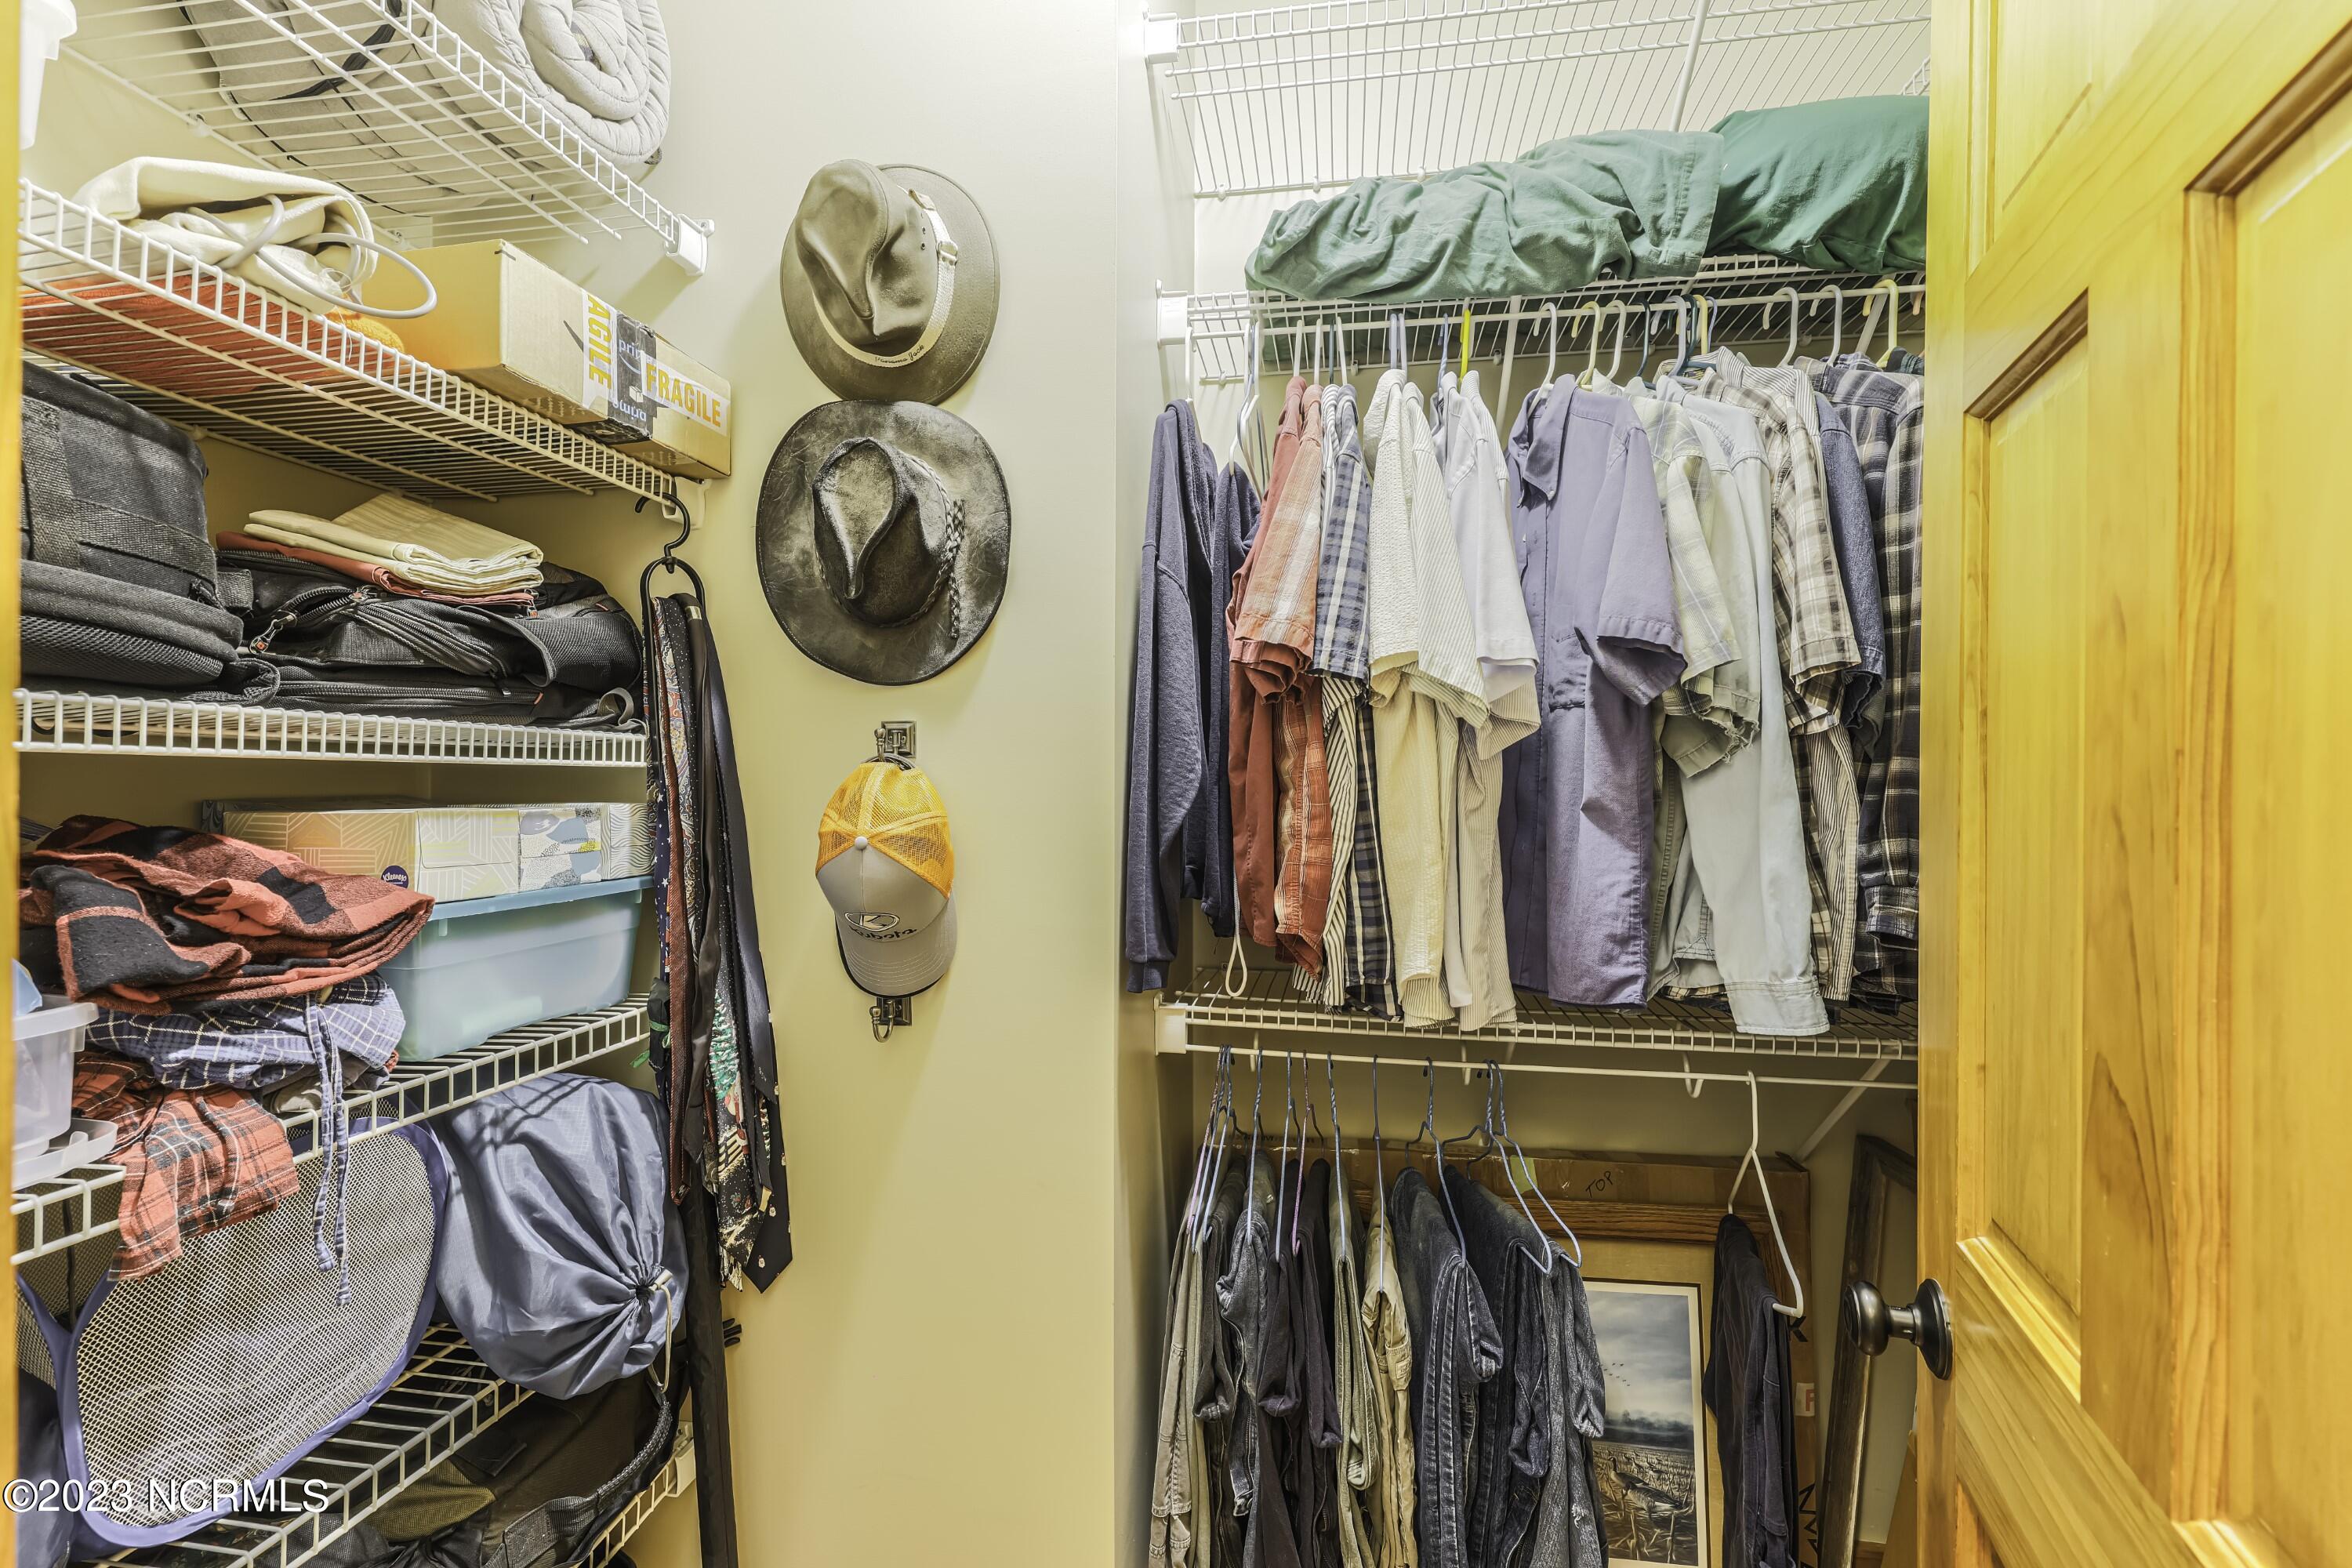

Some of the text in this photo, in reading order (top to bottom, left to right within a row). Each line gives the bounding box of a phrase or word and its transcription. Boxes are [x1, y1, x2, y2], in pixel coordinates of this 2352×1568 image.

[645, 362, 721, 427] FRAGILE
[383, 872, 407, 882] Kleenex
[1585, 1171, 1613, 1198] TOP
